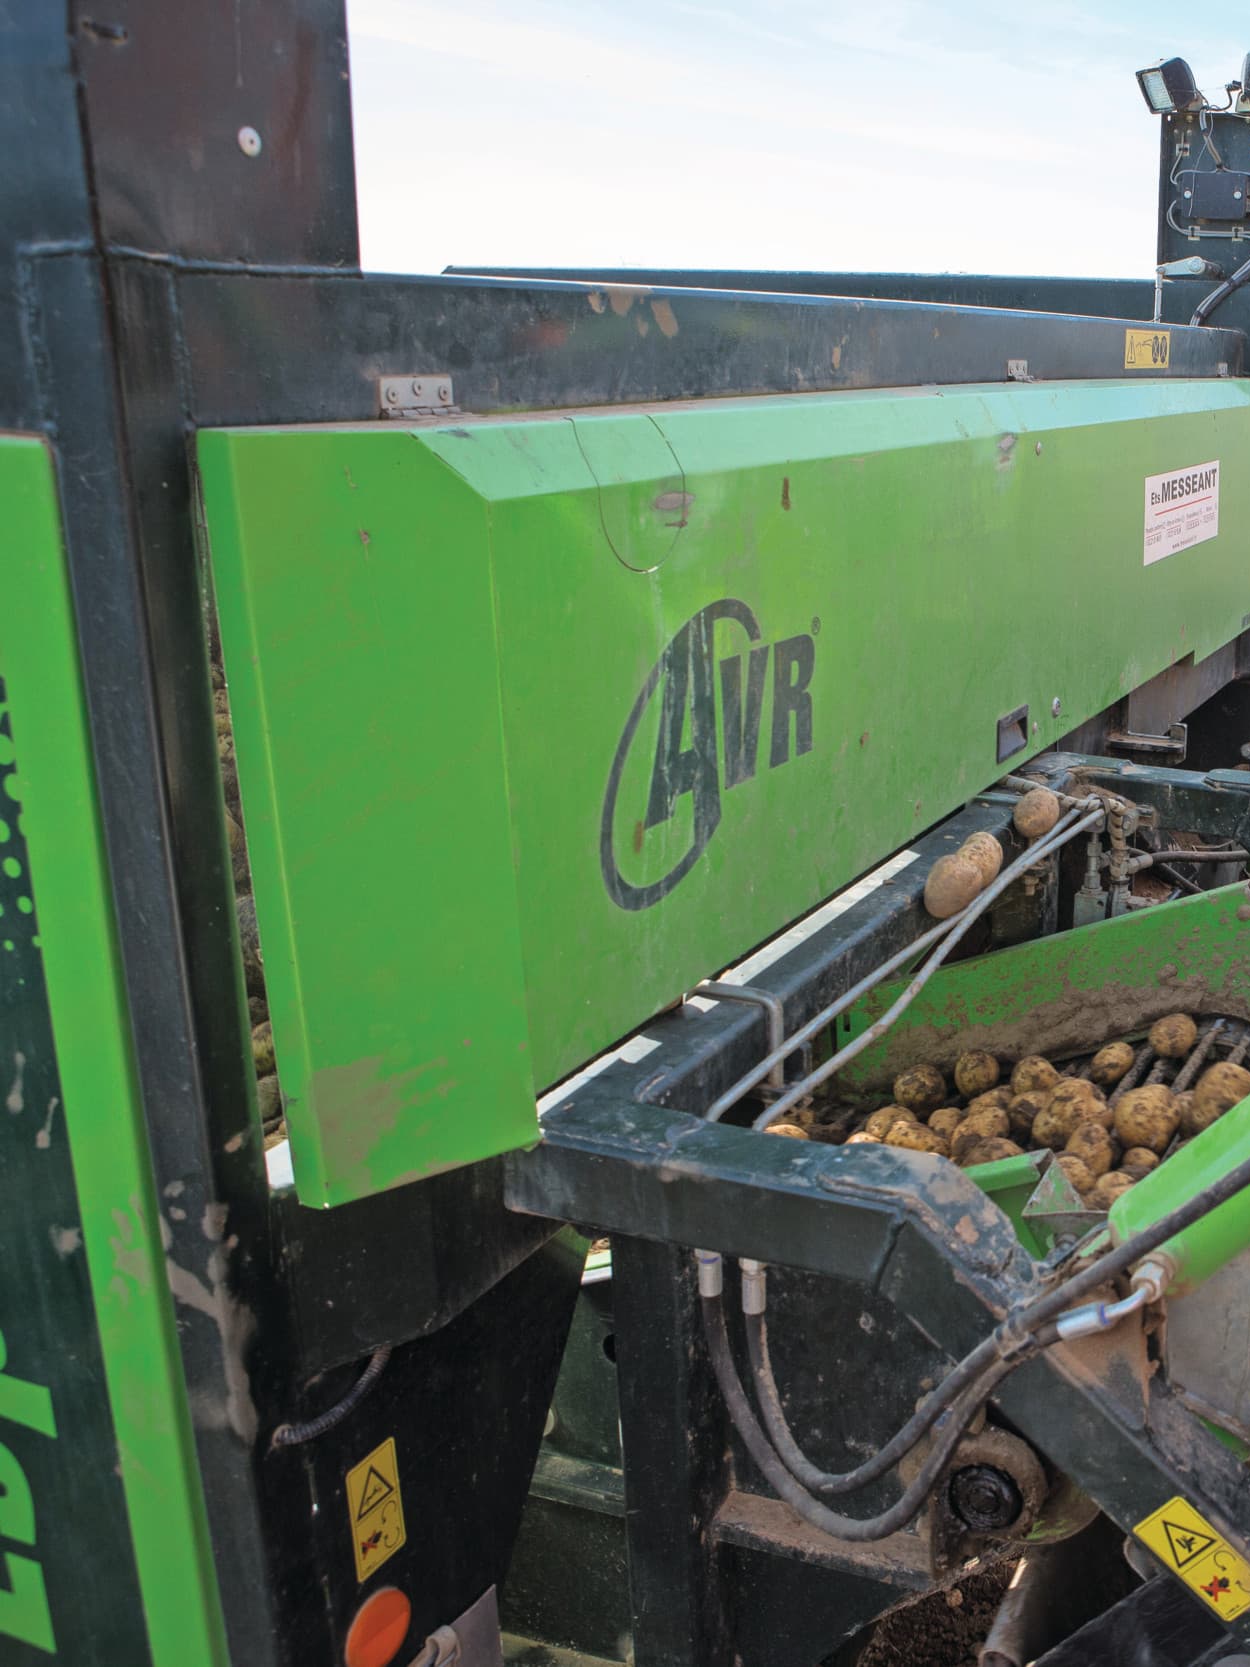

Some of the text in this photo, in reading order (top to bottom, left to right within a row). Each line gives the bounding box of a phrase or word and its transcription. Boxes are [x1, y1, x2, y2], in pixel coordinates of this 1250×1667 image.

[1151, 468, 1217, 505] Ets MESSEANT
[642, 607, 816, 831] AVR
